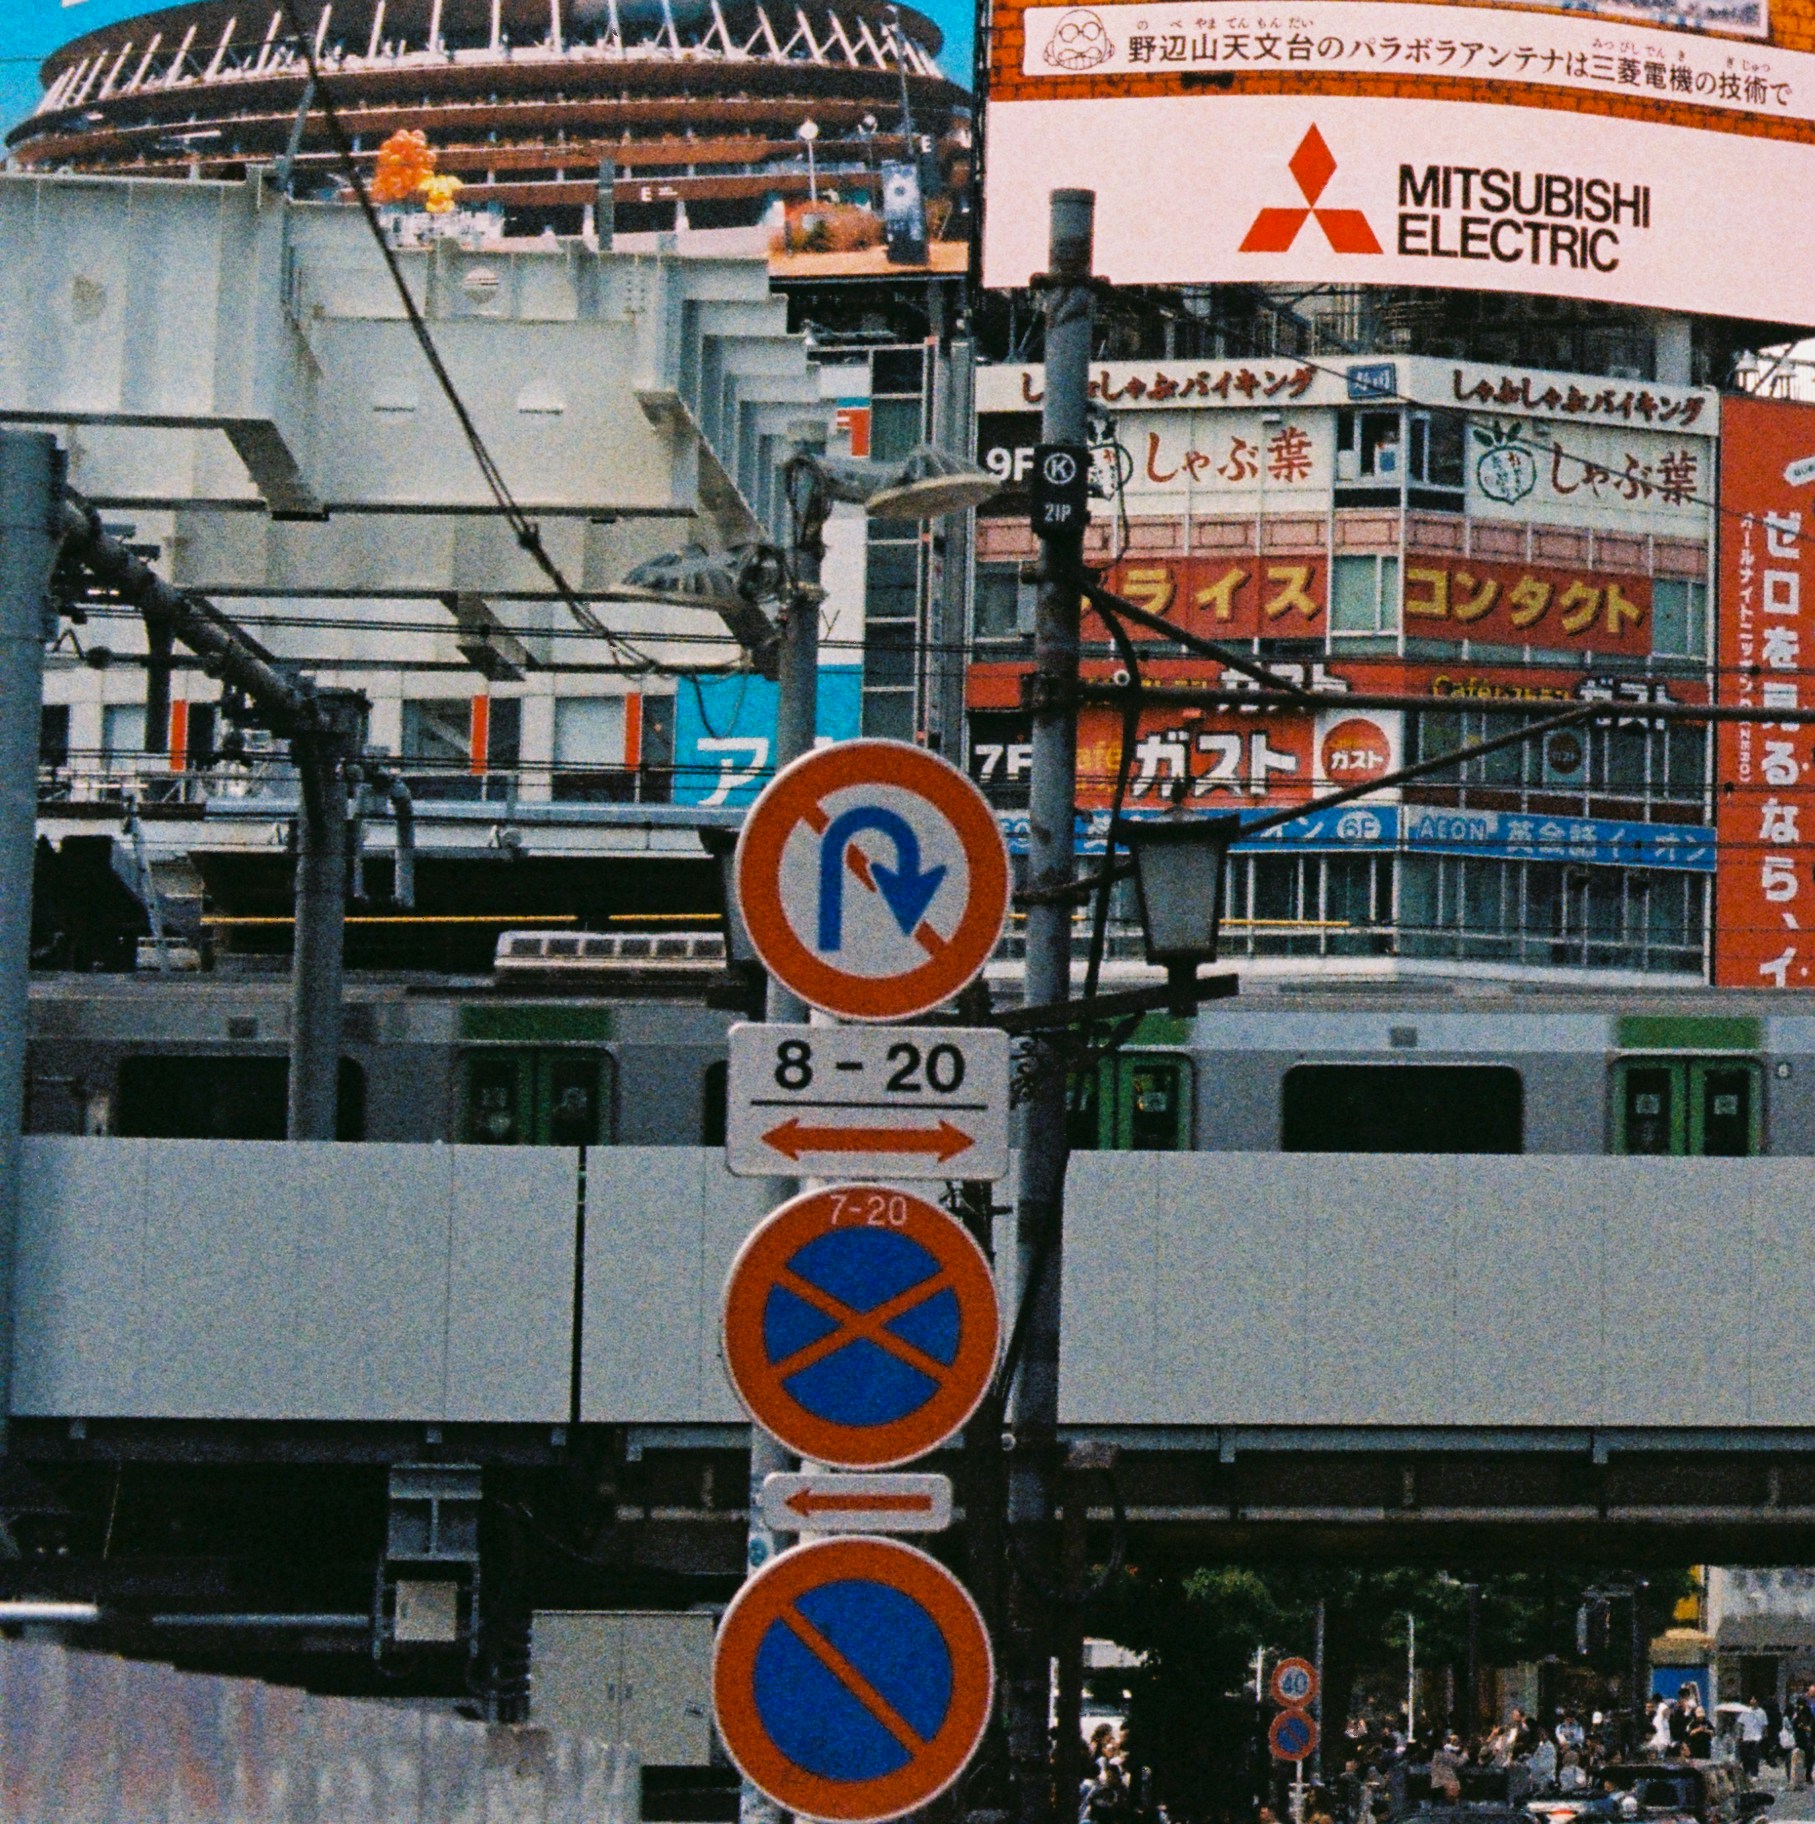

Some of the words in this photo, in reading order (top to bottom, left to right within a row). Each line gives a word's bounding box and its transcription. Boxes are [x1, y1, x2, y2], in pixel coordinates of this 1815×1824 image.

[1128, 32, 1793, 107] 野辺山天文台のパラボラアンテナは三菱電機の技術で
[1398, 162, 1652, 229] MITSUBISHI
[1398, 212, 1621, 275] ELECTRIC
[986, 446, 1035, 482] 9F
[1145, 426, 1313, 484] しゃぶ葉
[1551, 440, 1698, 507] しゃぶ葉
[1080, 564, 1323, 620] ライス
[1406, 565, 1645, 634] コンタクト
[1131, 730, 1299, 799] ガスト
[1330, 749, 1385, 771] ガスト
[1417, 816, 1489, 842] AEON
[829, 1194, 909, 1227] 7-20
